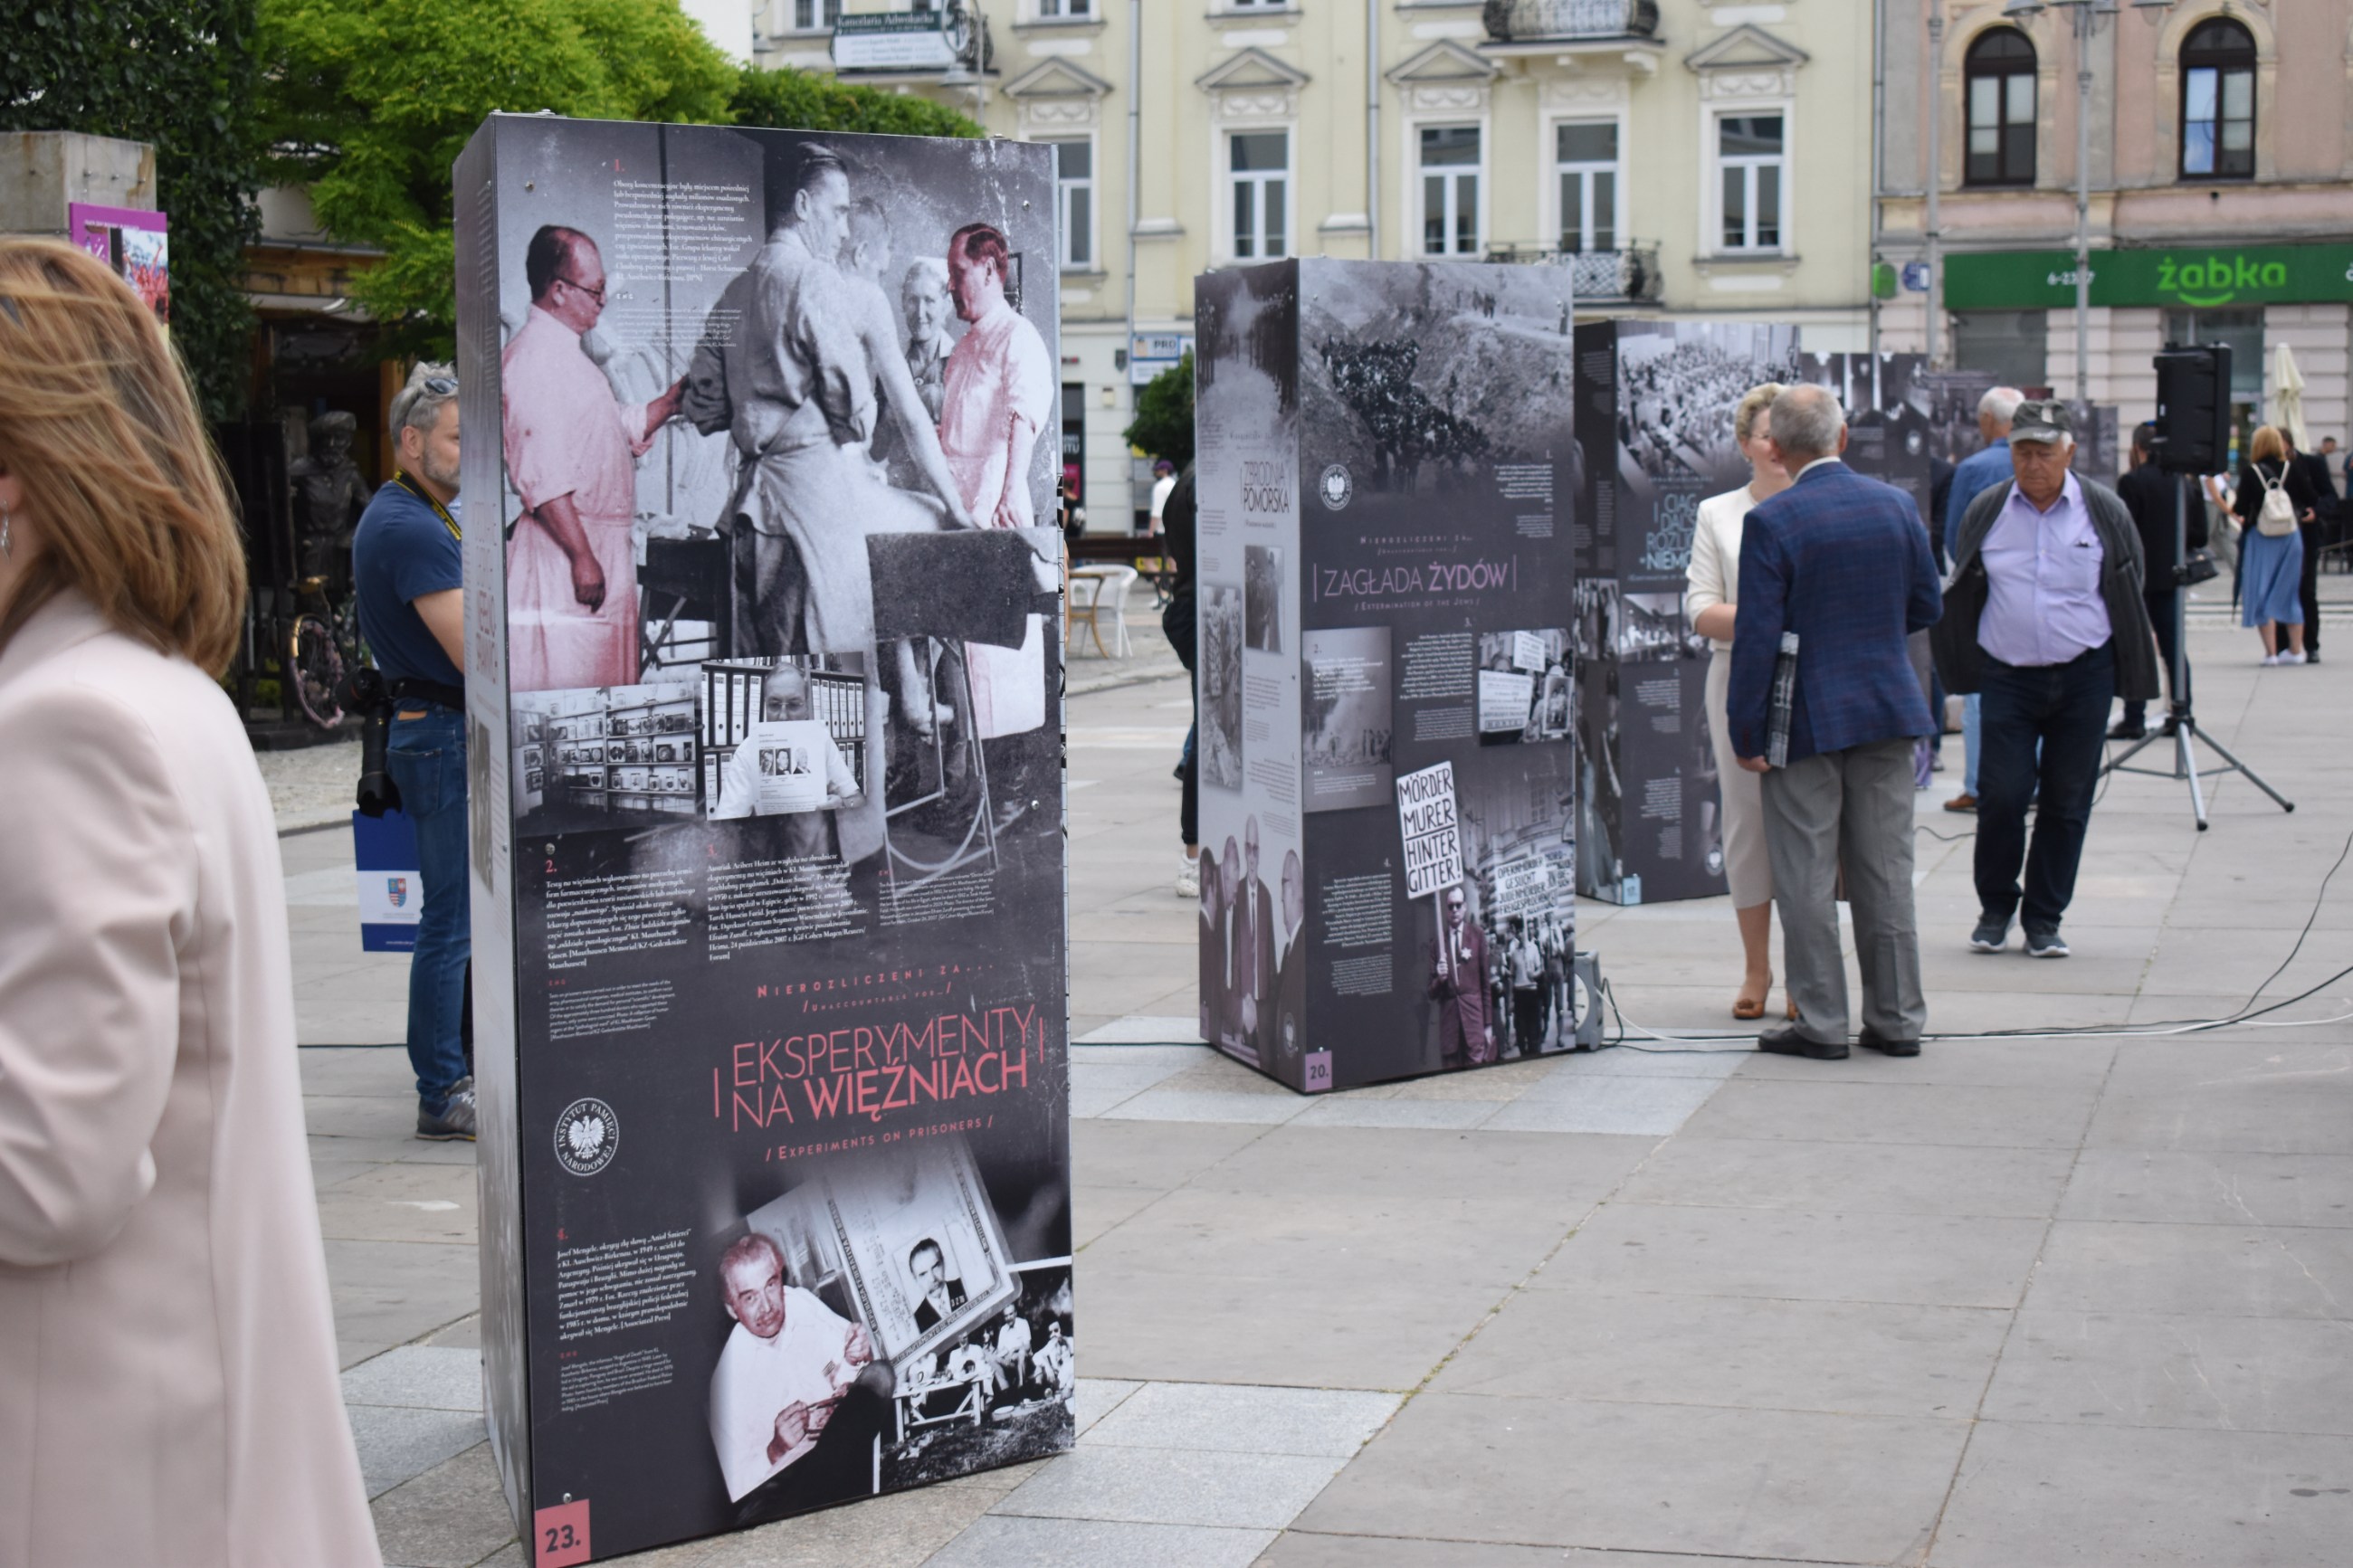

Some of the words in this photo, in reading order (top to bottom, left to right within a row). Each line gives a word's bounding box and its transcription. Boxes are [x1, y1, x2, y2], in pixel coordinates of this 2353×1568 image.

[2156, 255, 2286, 290] żabka
[1153, 339, 1176, 348] PRO
[1243, 487, 1290, 513] POMORSKA
[1323, 565, 1424, 596] ZAGŁADA
[1428, 556, 1508, 591] ŻYDÓW
[1398, 766, 1453, 806] MÖRDER
[1403, 797, 1454, 835] MURER
[546, 860, 557, 873] 2.
[1405, 829, 1458, 868] HINTER
[1407, 855, 1462, 893] GITTER!
[757, 969, 923, 998] NIEROZLICZENI
[732, 1003, 1036, 1087] EKSPERYMENTY
[1310, 1063, 1329, 1079] 20.
[732, 1082, 795, 1133] NA
[803, 1048, 1028, 1123] WIĘŹNIACH
[557, 1103, 587, 1148] INSTYTUT
[590, 1103, 615, 1140] PAMIĘCI
[778, 1135, 875, 1160] EXPERIMENTS
[883, 1129, 901, 1144] ON
[909, 1117, 983, 1140] PRISONERS
[561, 1145, 613, 1172] NARODOWEJ
[546, 1524, 581, 1553] 23.
